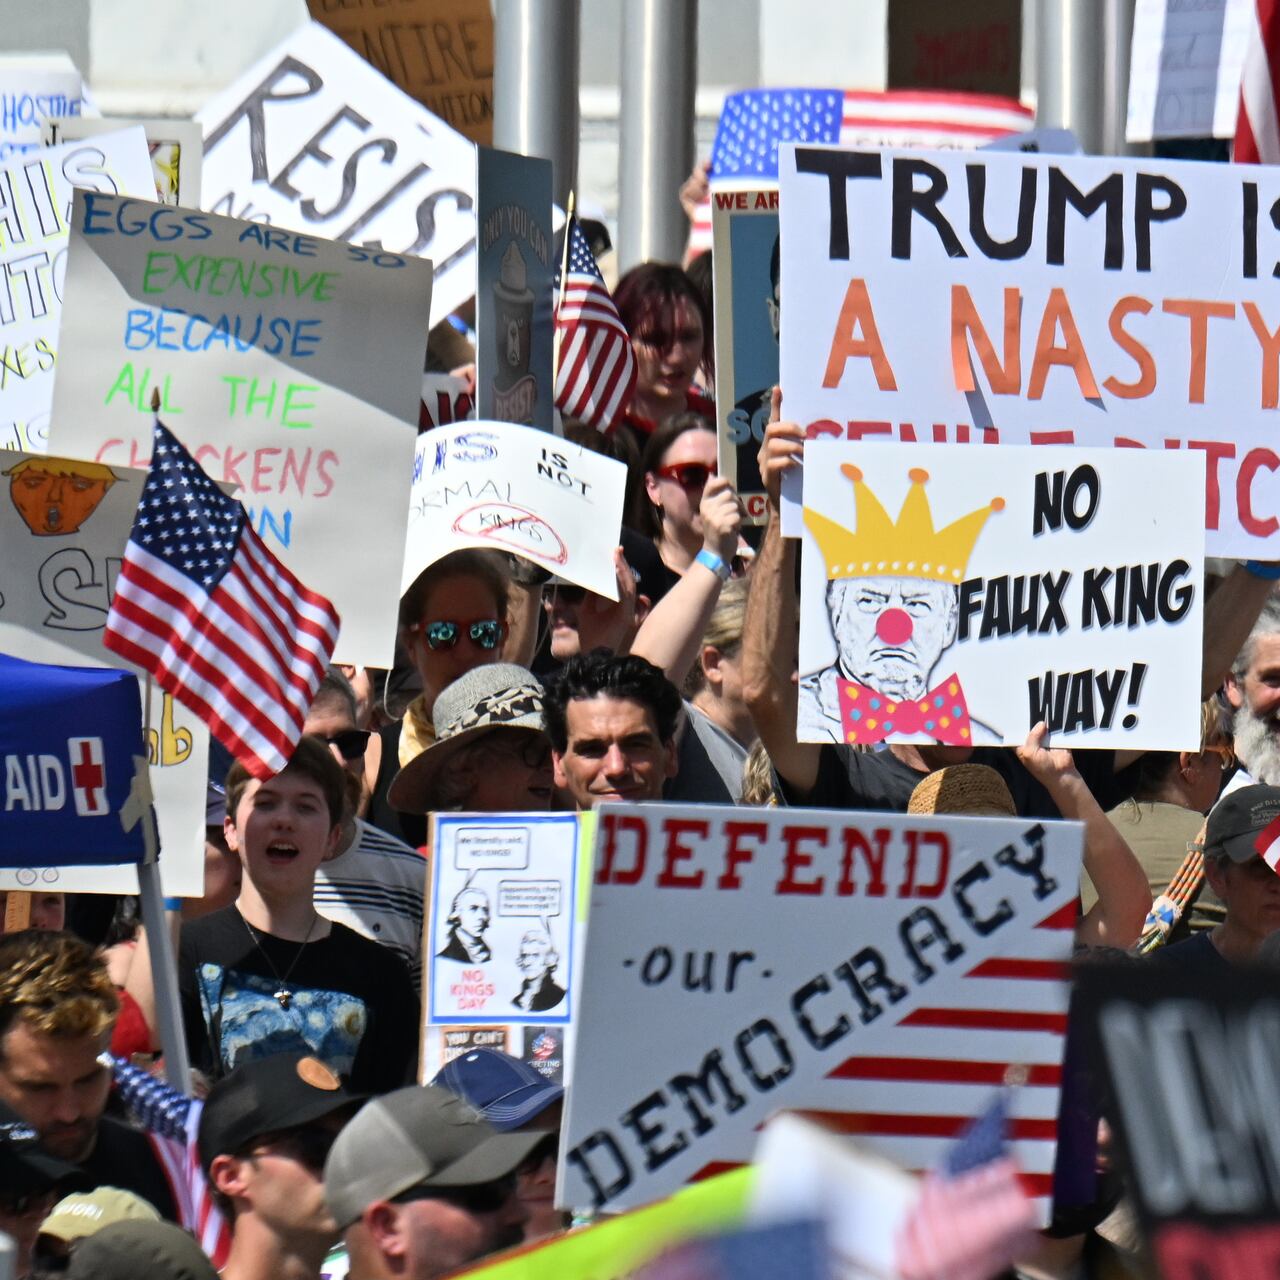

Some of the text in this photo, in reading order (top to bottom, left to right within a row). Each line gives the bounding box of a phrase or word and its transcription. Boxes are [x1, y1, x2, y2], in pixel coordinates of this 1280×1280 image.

[352, 21, 494, 88] NTIRE
[82, 193, 213, 242] EGGS
[239, 225, 318, 258] ARE
[507, 205, 527, 238] YOU
[714, 191, 780, 211] WE AR
[794, 147, 1187, 273] TRUMP
[143, 251, 343, 303] EXPENSIVE
[124, 308, 322, 359] BECAUSE
[822, 279, 898, 392] A
[105, 362, 320, 431] ALL THE
[94, 436, 341, 498] CHCKENS
[537, 462, 592, 497] NOT
[541, 448, 568, 471] IS
[1032, 463, 1101, 538] NO
[957, 558, 1195, 643] FAUX KING
[1027, 662, 1149, 736] WAY!
[4, 753, 66, 812] AID
[594, 813, 951, 899] DEFEND
[449, 983, 496, 997] KINGS
[457, 998, 487, 1010] DAY
[462, 969, 485, 983] NO
[445, 1032, 469, 1046] YOU
[565, 823, 1059, 1203] DEMOCRACY
